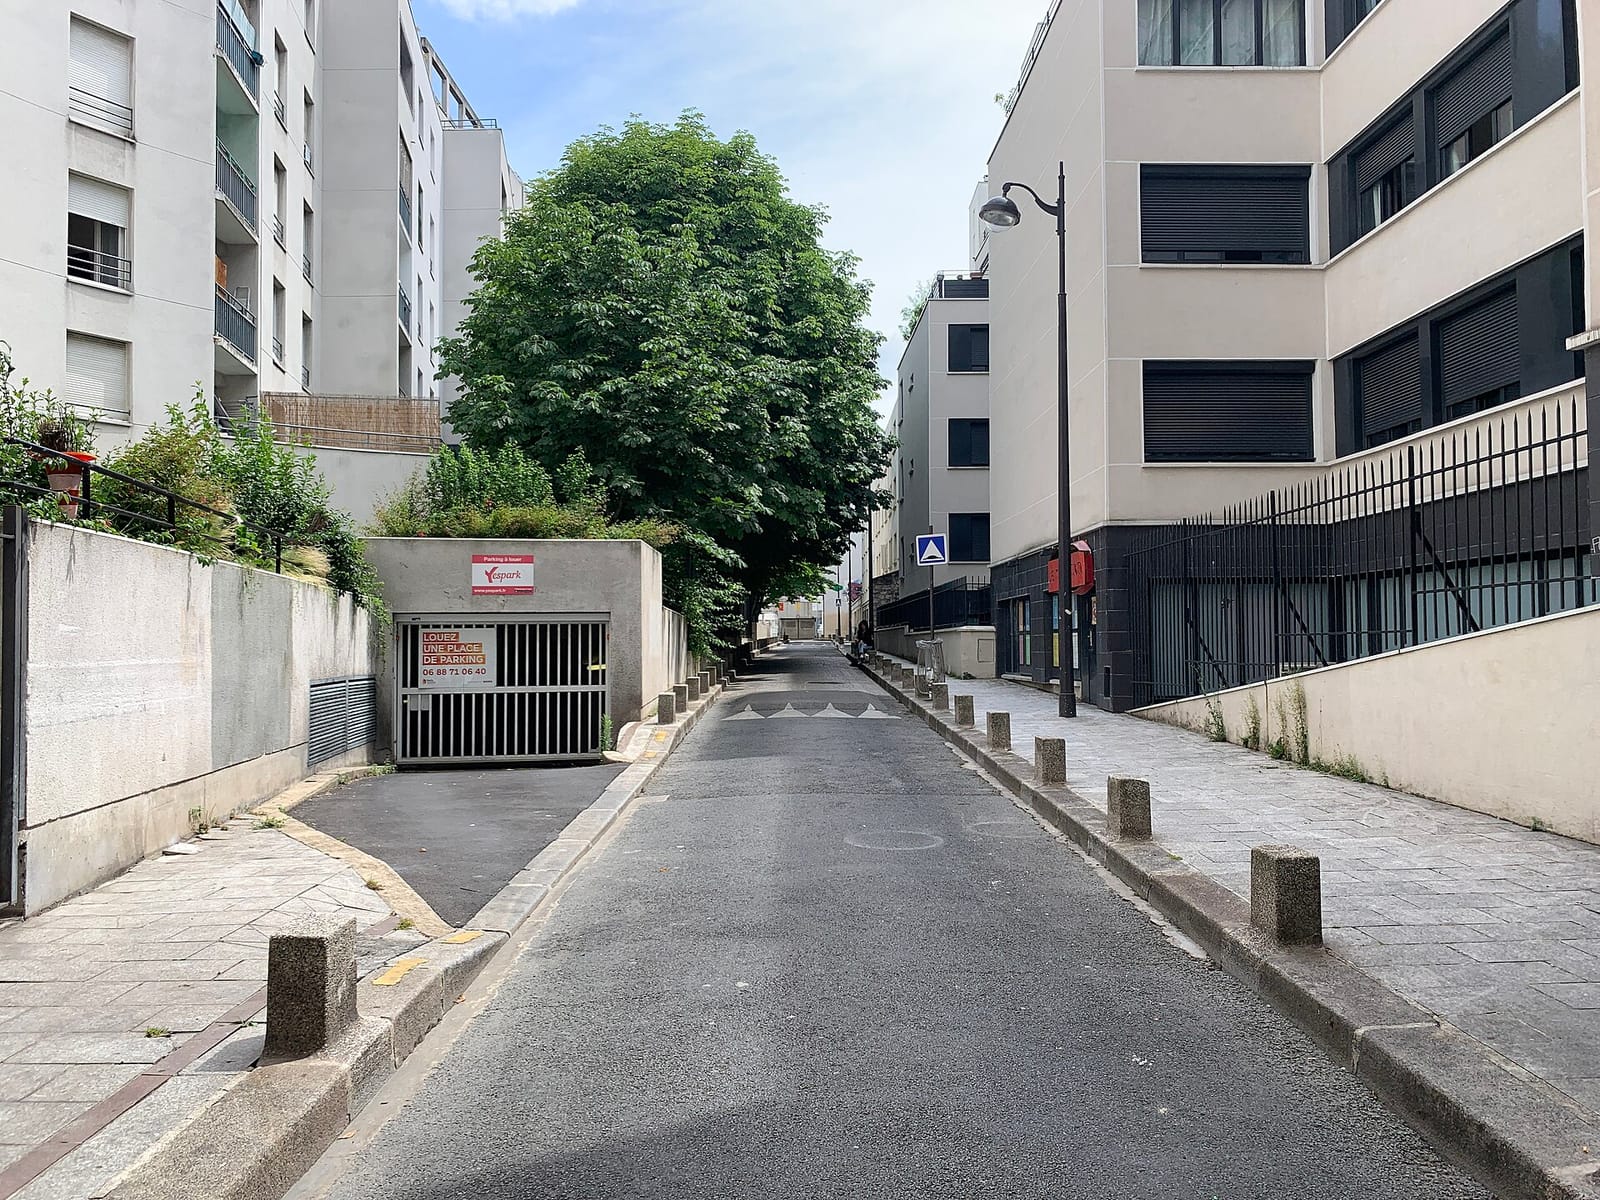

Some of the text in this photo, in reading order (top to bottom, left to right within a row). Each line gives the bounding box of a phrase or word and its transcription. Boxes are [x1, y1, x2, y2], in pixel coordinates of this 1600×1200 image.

[485, 566, 521, 583] Yespark
[423, 633, 457, 641] LOUEZ
[423, 644, 480, 653] UNE PLACE
[423, 655, 484, 664] DE PARKING
[422, 668, 434, 676] 06
[436, 668, 447, 676] 88
[475, 667, 487, 675] 40
